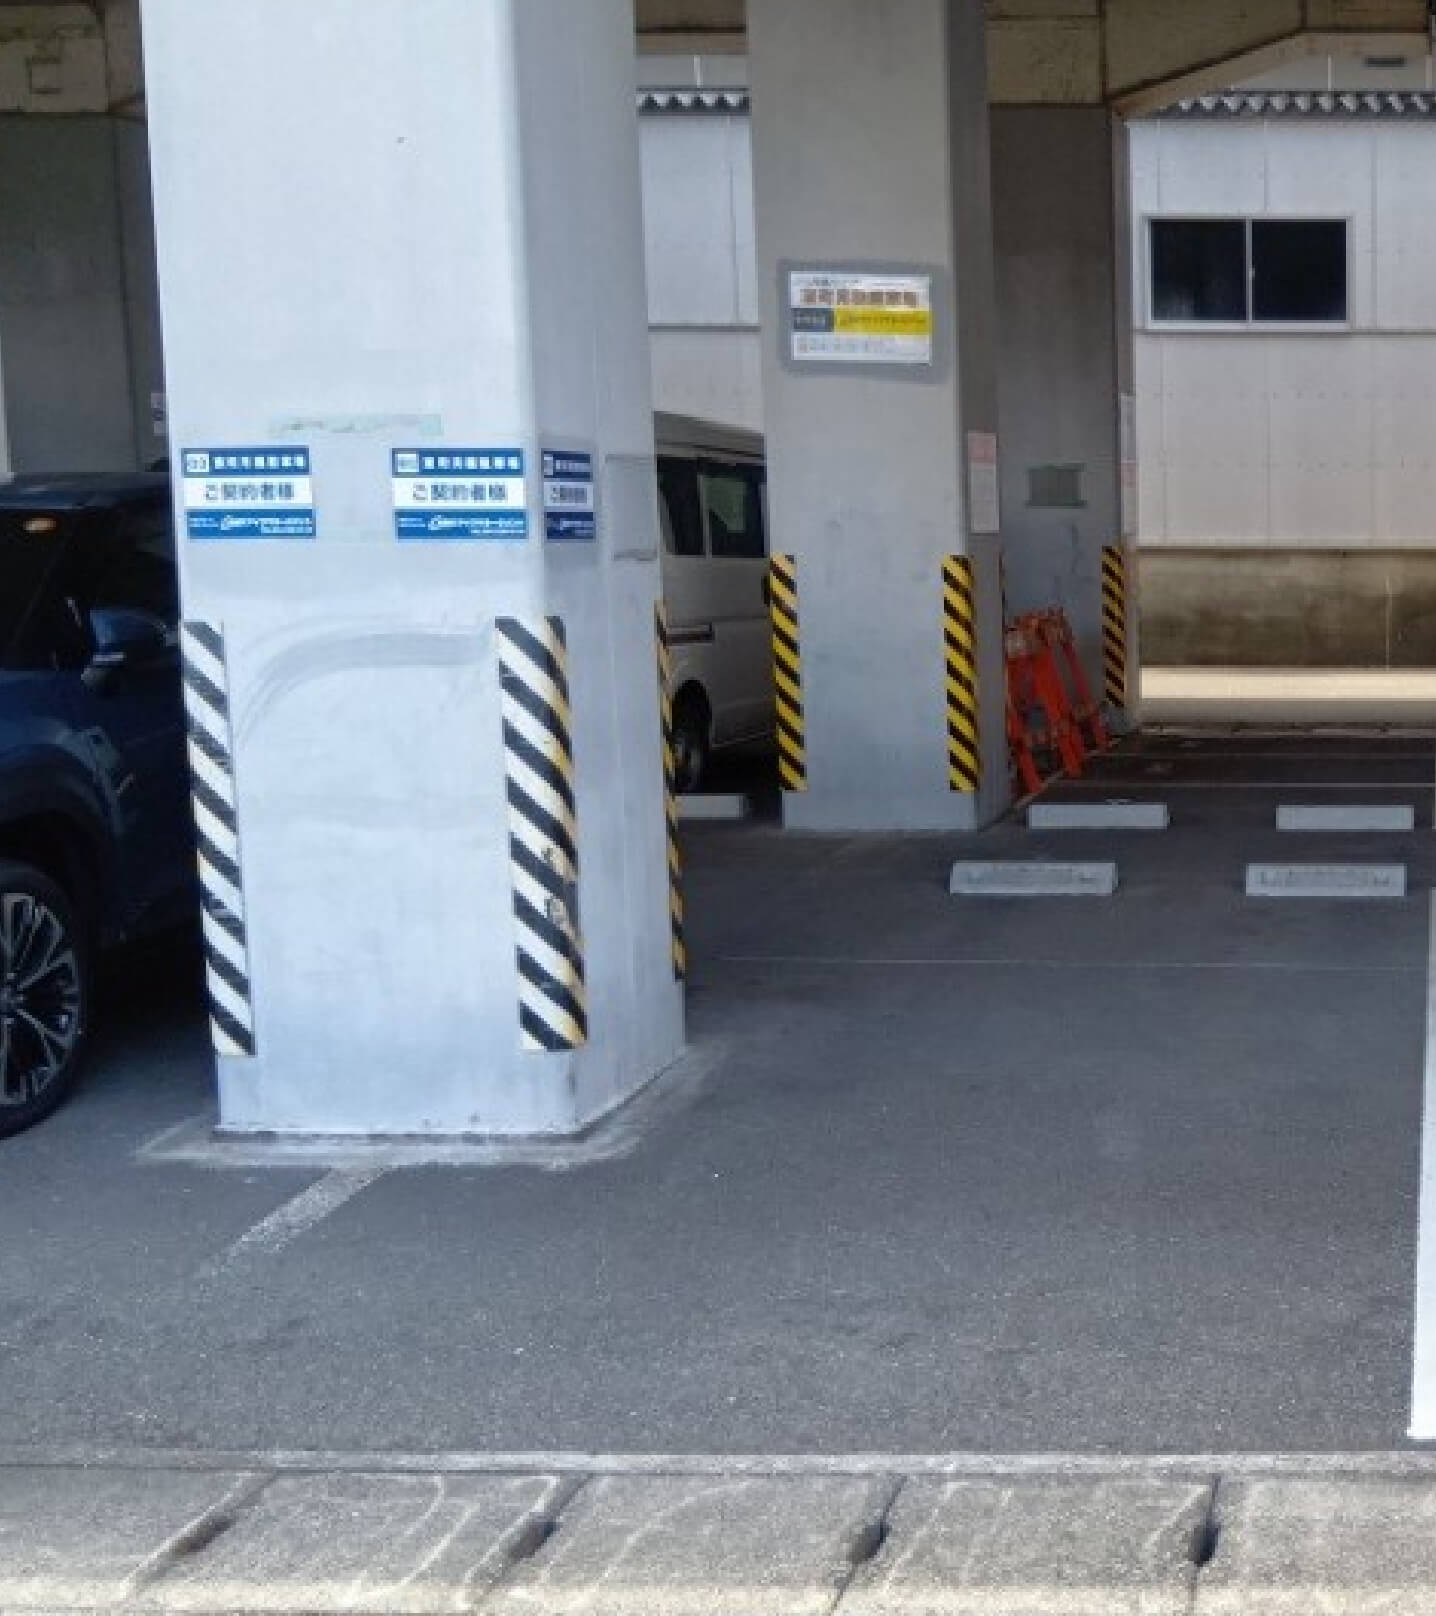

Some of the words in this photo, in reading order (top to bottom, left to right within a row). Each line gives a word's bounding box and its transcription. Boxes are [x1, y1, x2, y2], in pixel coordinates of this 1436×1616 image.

[413, 482, 508, 503] ご契約者様
